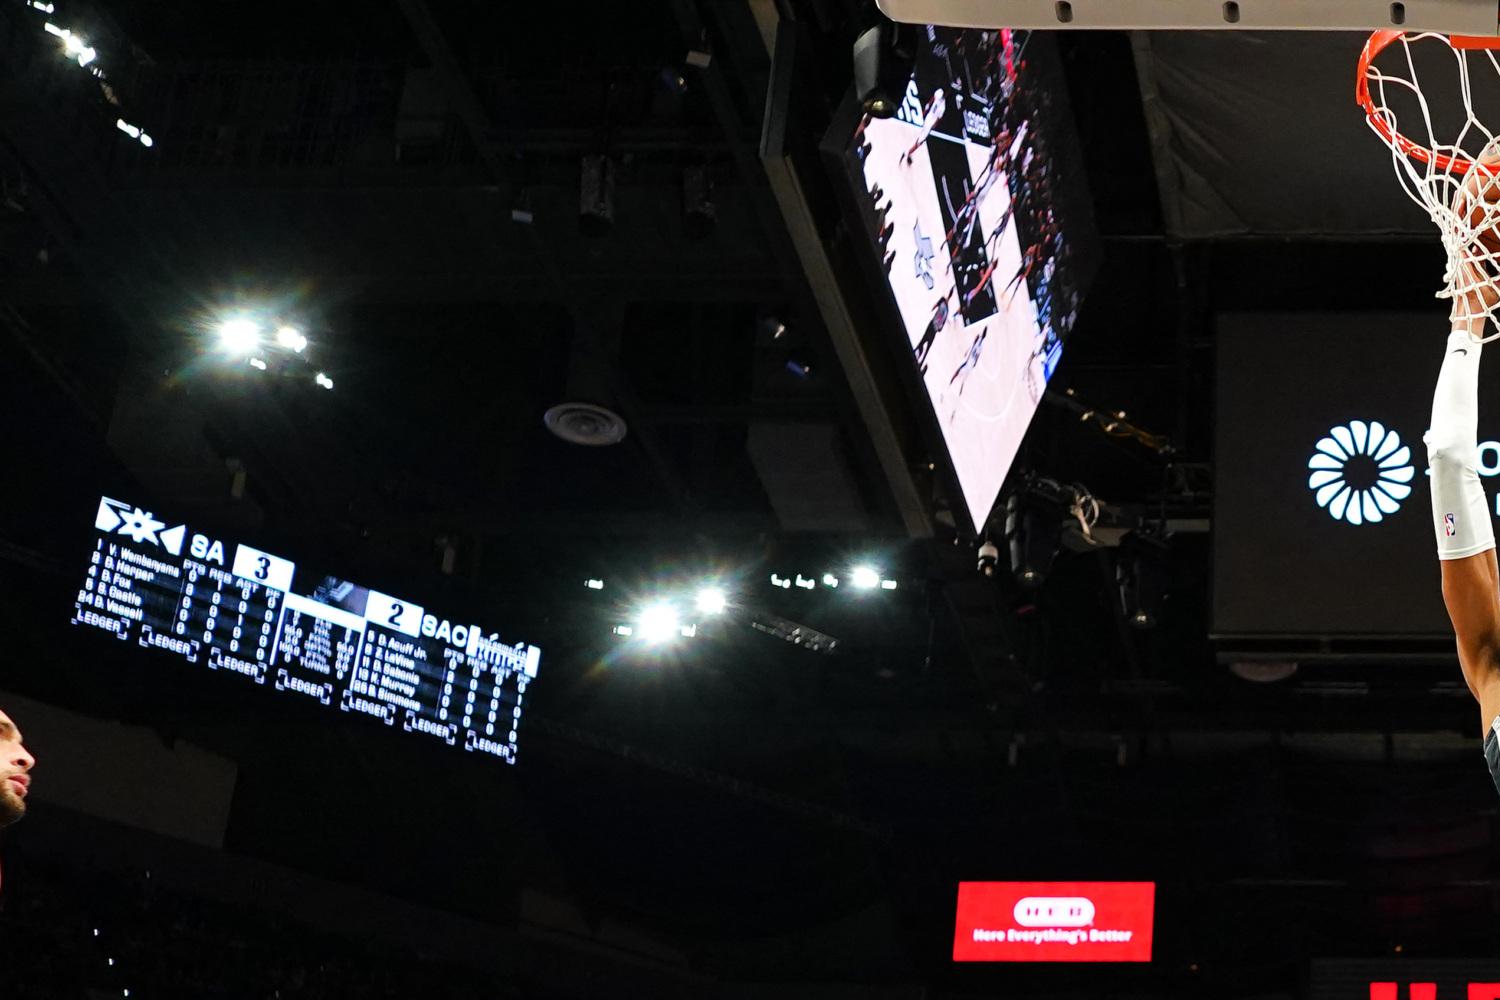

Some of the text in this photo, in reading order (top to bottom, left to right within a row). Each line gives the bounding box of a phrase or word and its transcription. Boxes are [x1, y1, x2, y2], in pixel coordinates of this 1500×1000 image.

[191, 534, 223, 565] SA
[254, 556, 271, 580] 3
[113, 573, 131, 589] Fox
[77, 609, 121, 633] LEDGER
[388, 603, 404, 626] 2
[422, 615, 468, 647] SAC
[148, 631, 191, 656] LEDGER
[217, 654, 258, 676] LEDGER
[284, 675, 325, 698] LEDGER
[348, 695, 388, 718] LEDGER
[411, 716, 450, 738] LEDGER
[473, 736, 510, 757] LEDGER
[1007, 929, 1088, 945] Everything's
